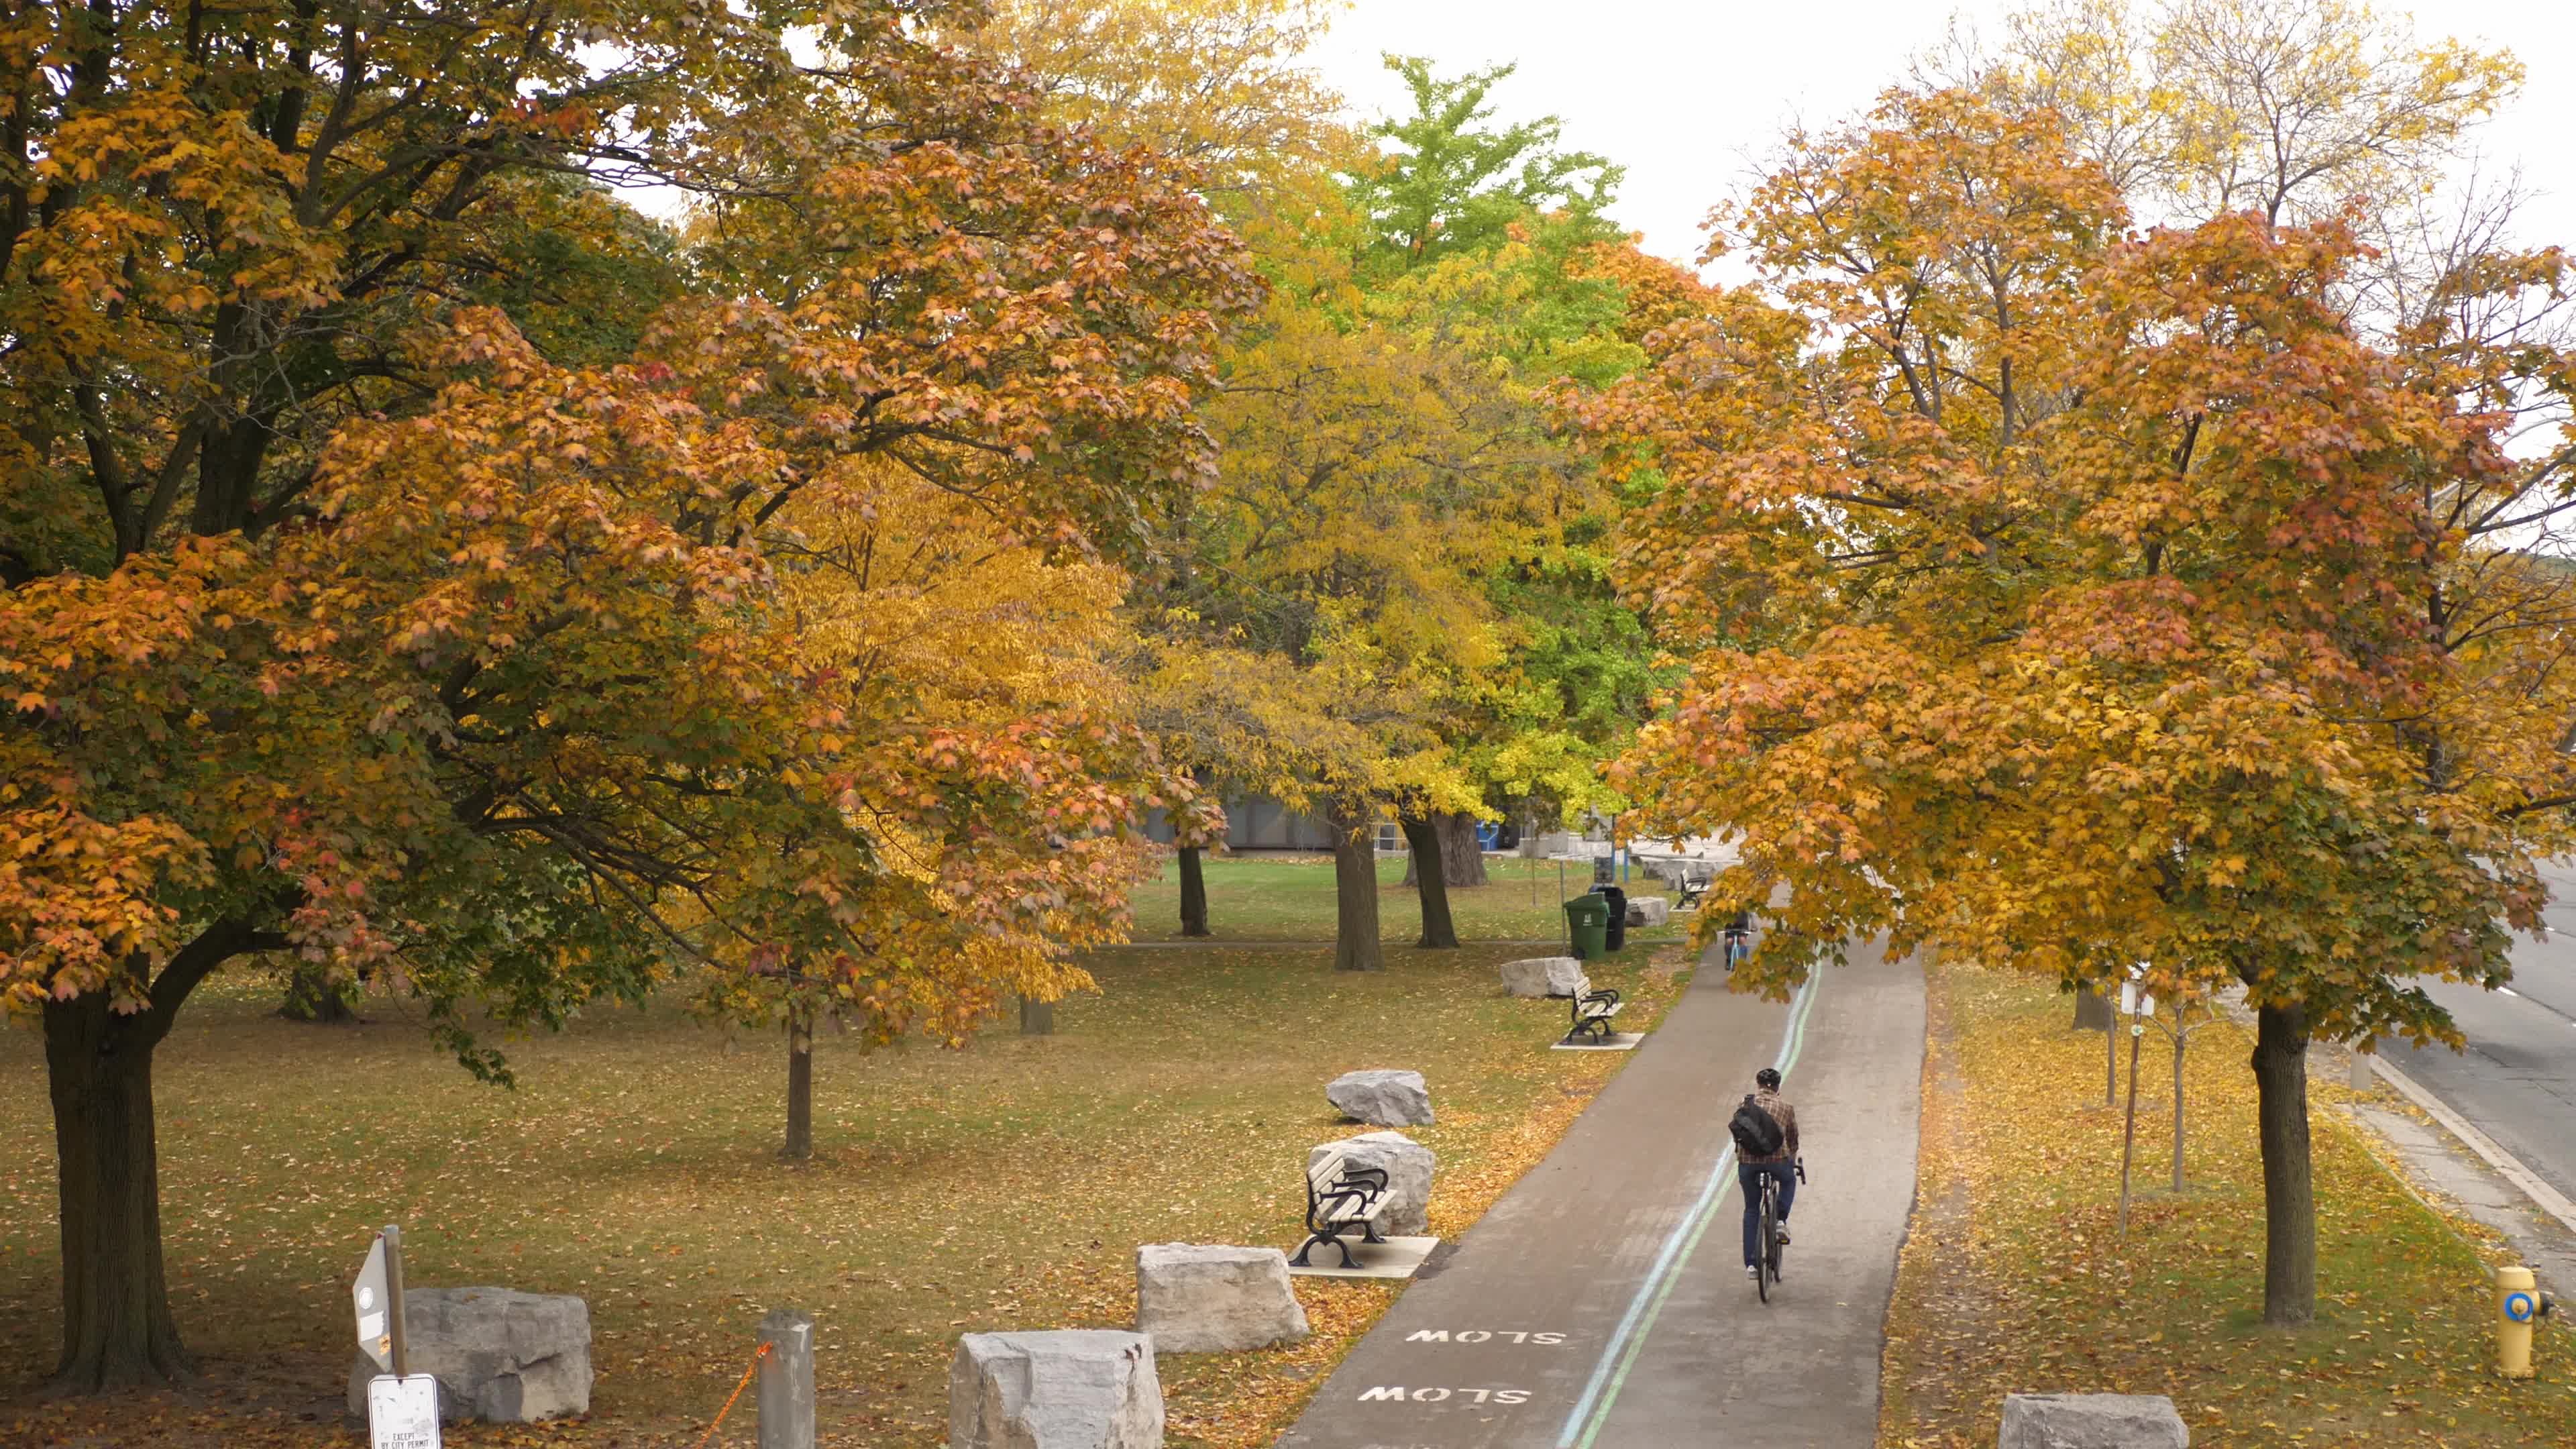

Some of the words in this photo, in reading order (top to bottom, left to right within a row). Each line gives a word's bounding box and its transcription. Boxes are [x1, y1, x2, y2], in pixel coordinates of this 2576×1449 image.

[1405, 1330, 1568, 1344] SLOW
[1357, 1387, 1532, 1404] SLOW
[393, 1433, 415, 1441] EXCEPT
[392, 1441, 405, 1449] CITY
[407, 1439, 429, 1448] PERMIT
